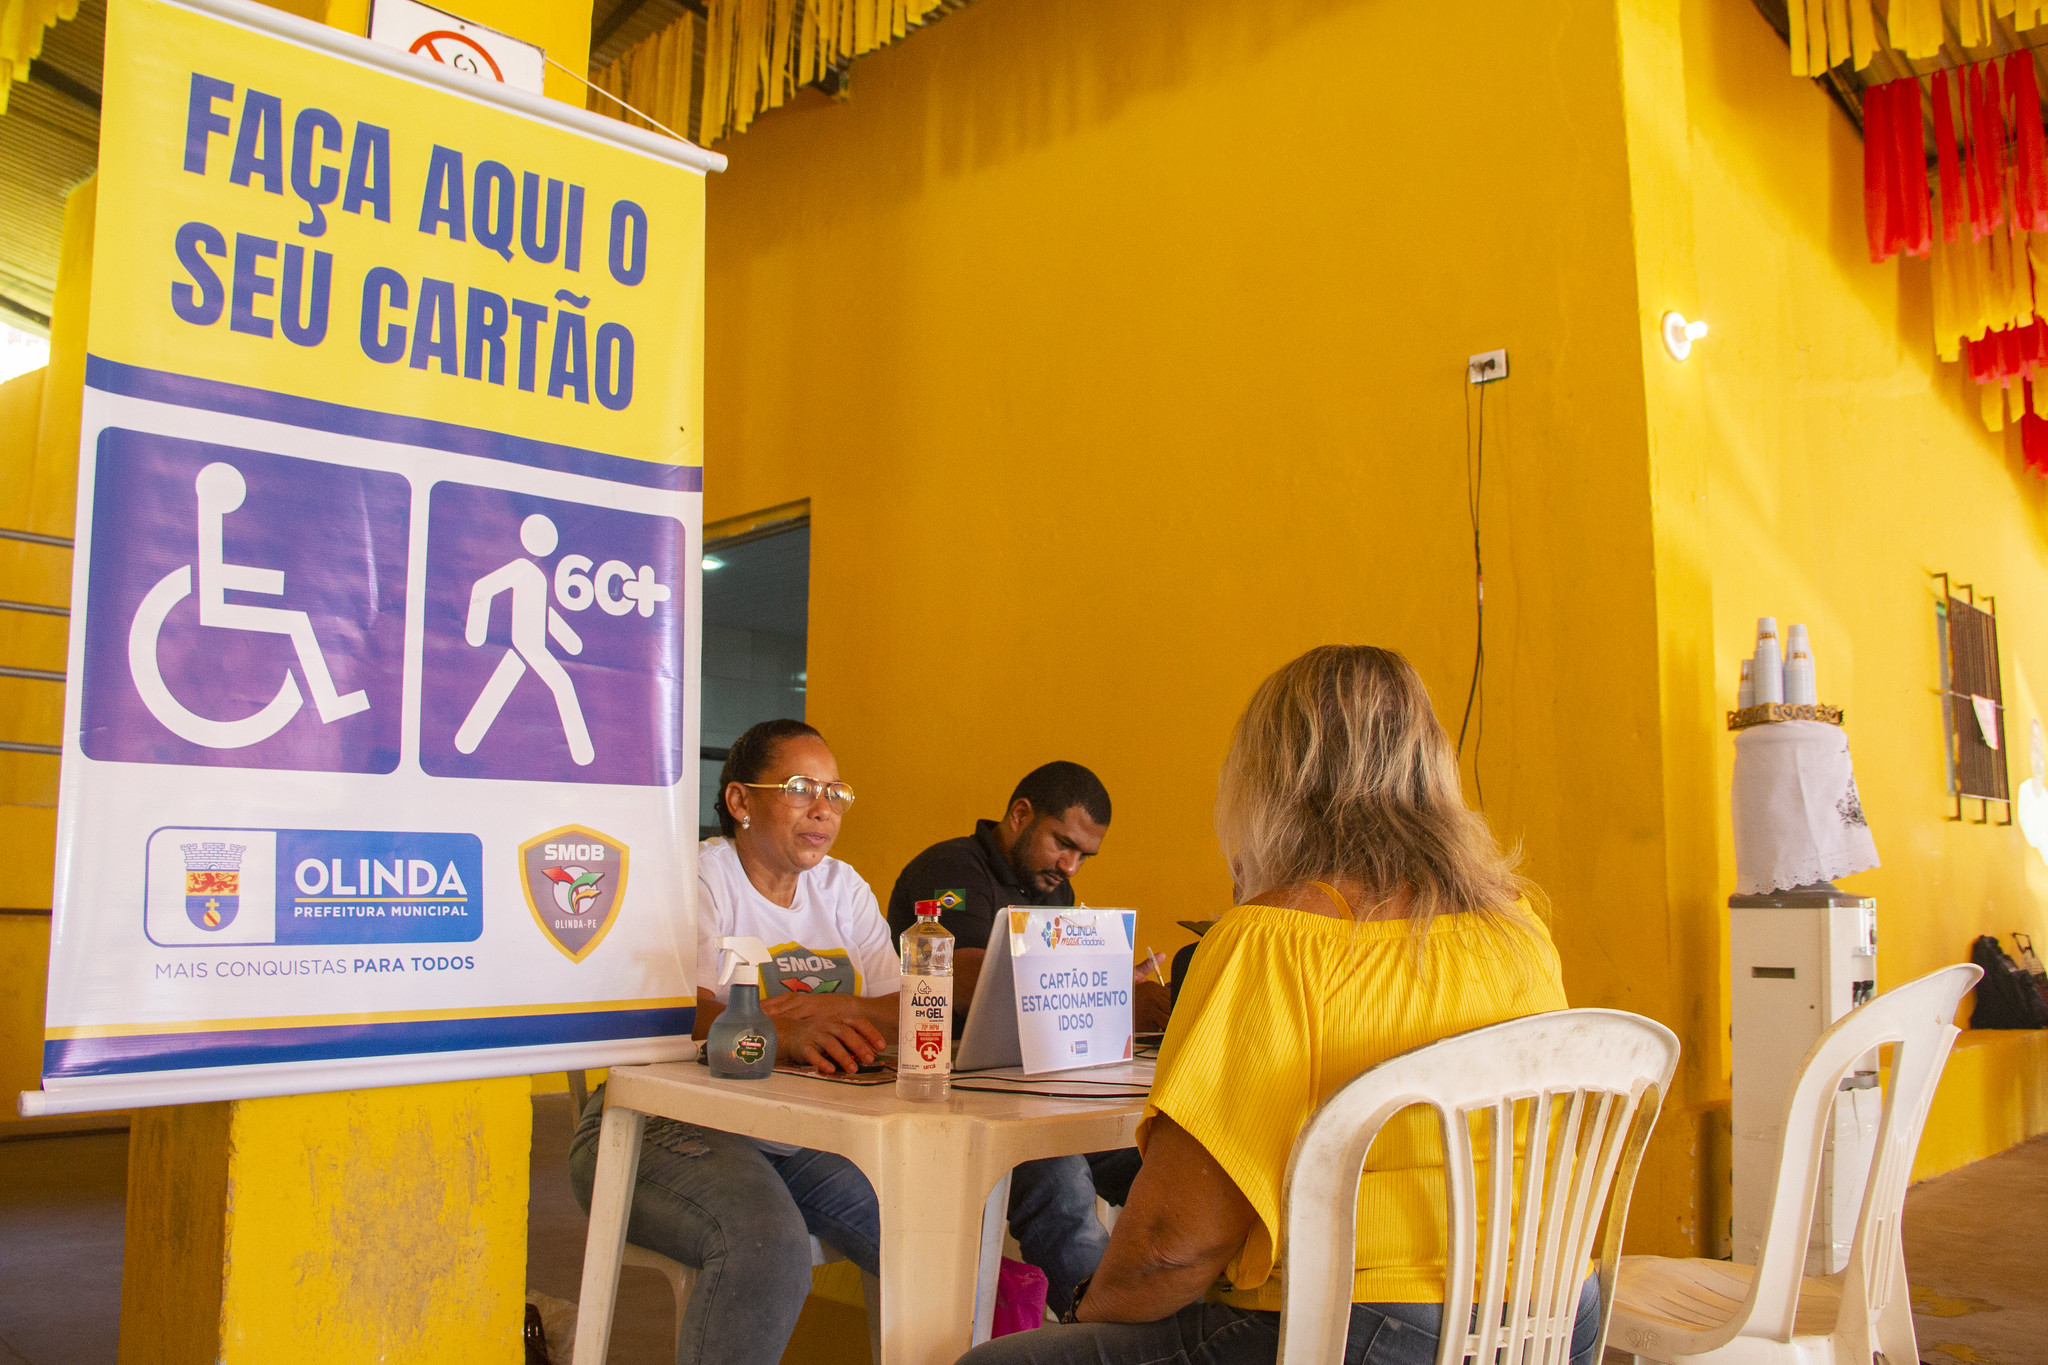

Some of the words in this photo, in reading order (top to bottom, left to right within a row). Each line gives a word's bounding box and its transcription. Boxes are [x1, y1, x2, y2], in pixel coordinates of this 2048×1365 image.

[183, 72, 391, 237] FAÇA
[418, 144, 586, 273] AQUI
[608, 199, 648, 287] O
[171, 221, 333, 347] SEU
[359, 266, 635, 411] CARTÃO
[544, 843, 605, 861] SMOB
[294, 858, 468, 895] OLINDA
[294, 905, 386, 918] PREFEITURA
[391, 905, 469, 917] MUNICIPAL
[555, 919, 598, 929] OLINDA-PE
[1065, 924, 1098, 937] OLINDA
[155, 962, 208, 980] MAIS
[215, 959, 347, 978] CONQUISTAS
[353, 958, 405, 974] PARA
[411, 955, 475, 972] TODOS
[776, 955, 837, 973] SMOB
[1039, 968, 1089, 990] CARTÃO
[1092, 971, 1109, 987] DE
[911, 993, 948, 1007] ÁLCOOL
[1021, 990, 1128, 1013] ESTACIONAMENTO
[915, 1010, 926, 1018] EM
[926, 1008, 944, 1019] GEL
[1058, 1012, 1094, 1031] IDOSO
